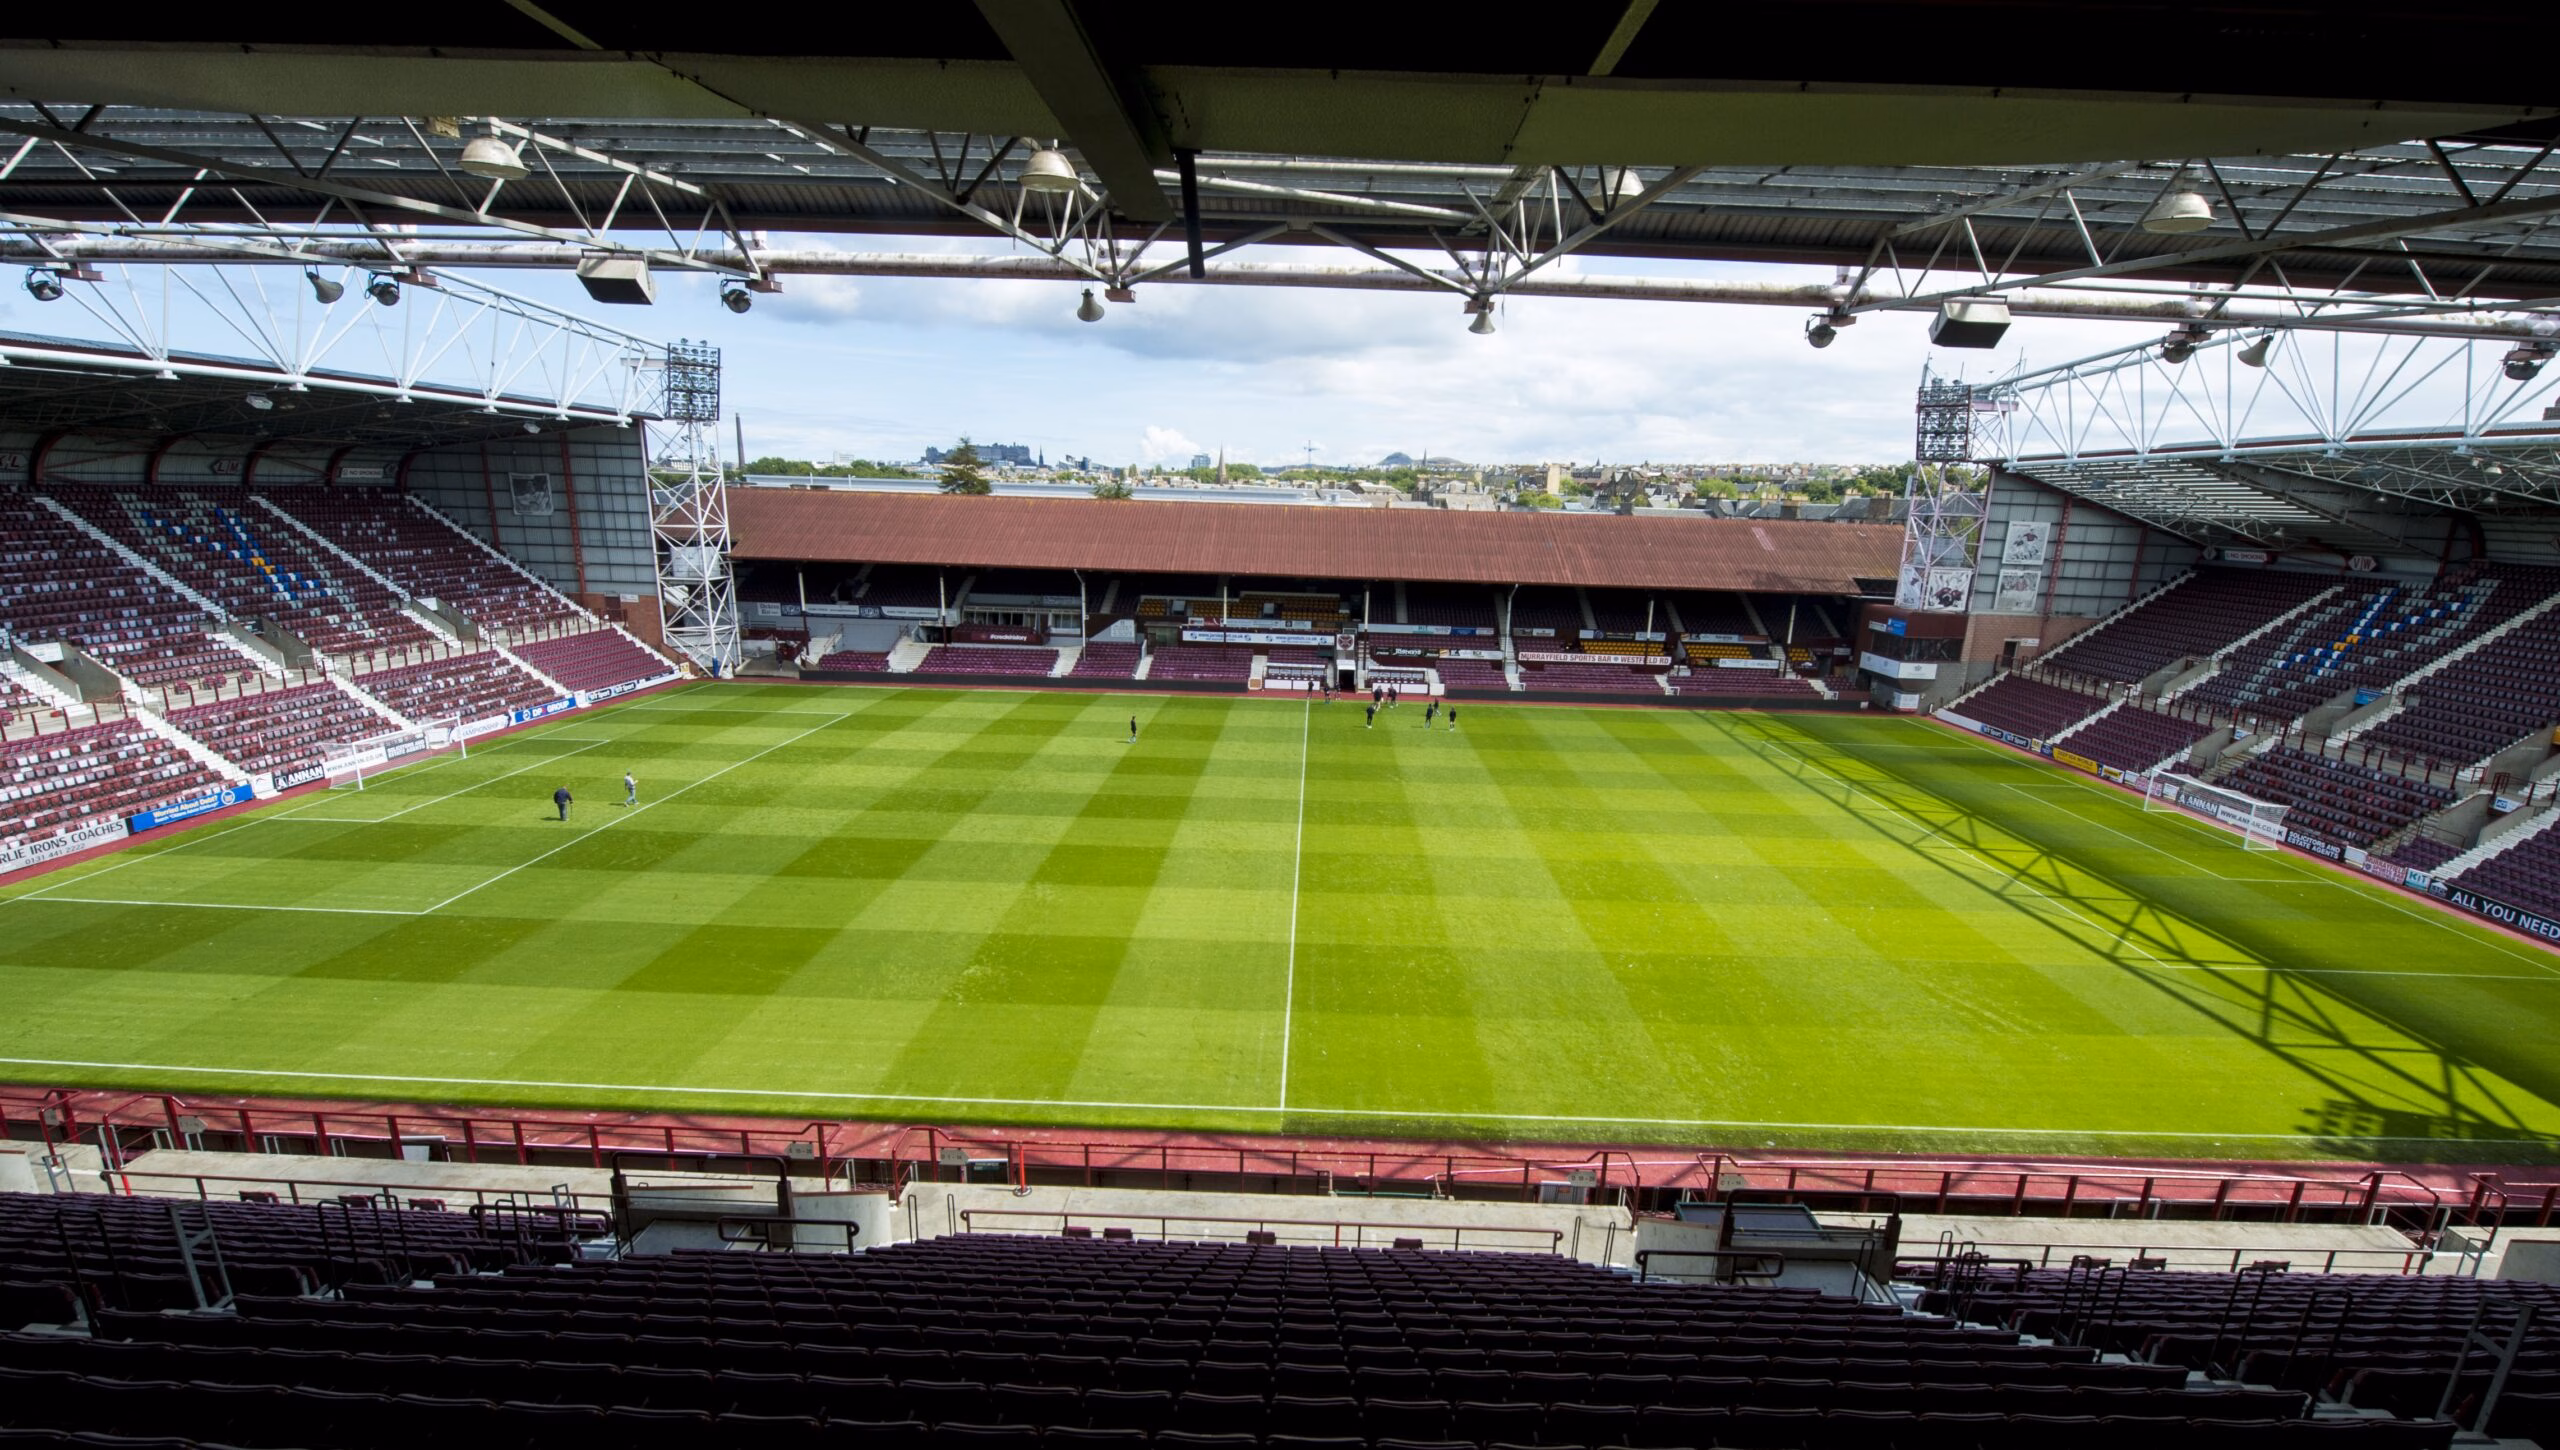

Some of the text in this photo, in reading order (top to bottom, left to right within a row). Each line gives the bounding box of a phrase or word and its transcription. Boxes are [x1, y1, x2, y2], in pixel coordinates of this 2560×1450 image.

[1520, 652, 1568, 661] MURRAYFIELD
[1570, 654, 1596, 662] SPORTS
[1620, 655, 1658, 664] WESTFLD
[547, 699, 570, 714] GROUP
[288, 765, 324, 785] ANNAN
[2186, 796, 2218, 813] ANNAN
[30, 838, 68, 855] IRONS
[71, 821, 124, 843] COACHES
[2287, 837, 2340, 860] ESTATE AGENTS
[2289, 831, 2341, 854] SOLICITORS AND
[25, 855, 46, 866] 0131
[66, 843, 86, 854] 2222
[2409, 871, 2428, 884] KIT
[2451, 891, 2560, 939] ALL YOU NEED
